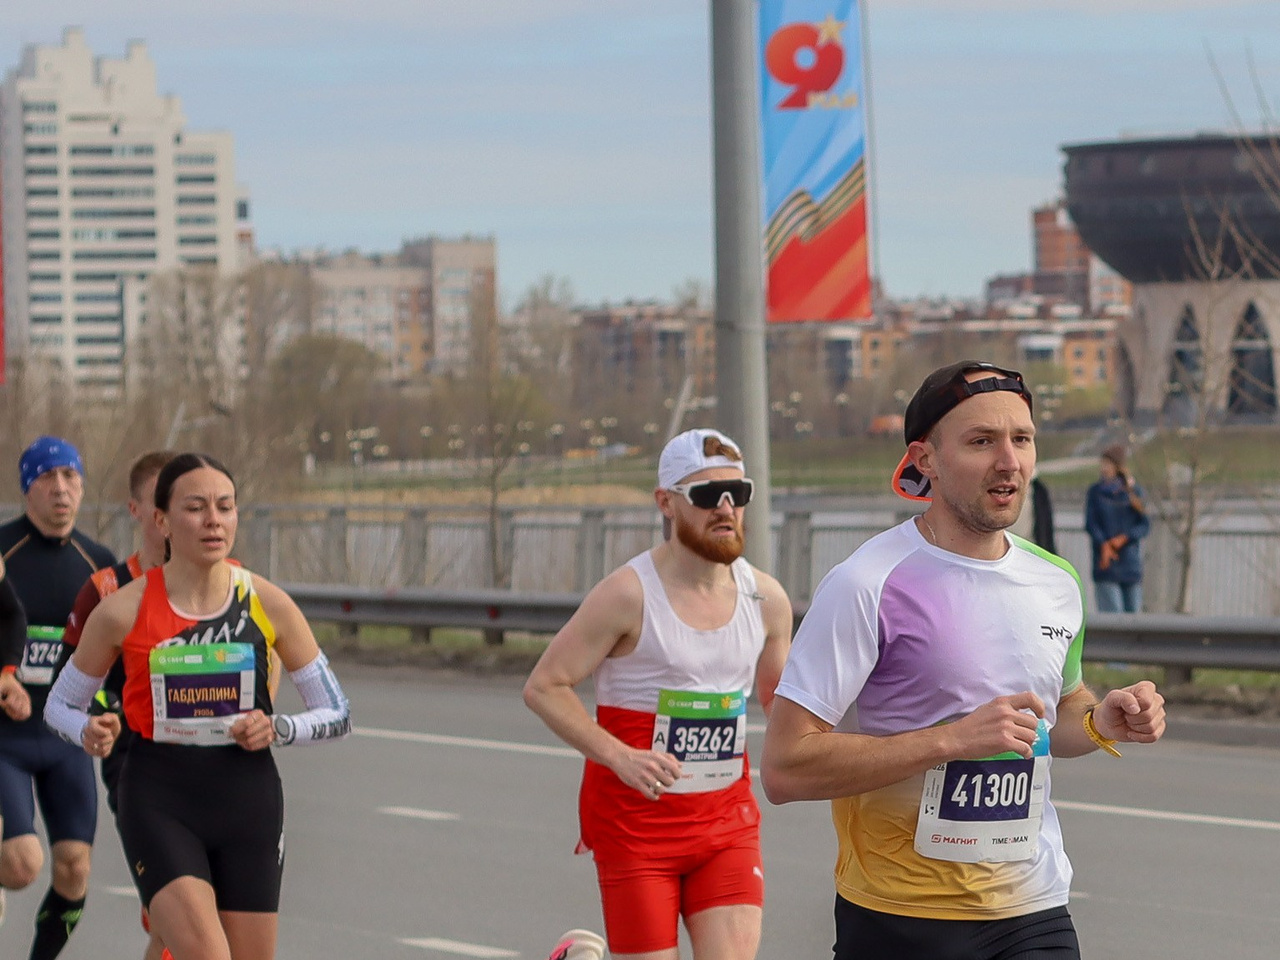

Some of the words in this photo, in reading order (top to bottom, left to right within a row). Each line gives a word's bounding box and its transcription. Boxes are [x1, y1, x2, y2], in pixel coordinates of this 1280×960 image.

[167, 686, 238, 704] ГАБДУЛЛИНА
[673, 726, 735, 753] 35262
[951, 772, 1029, 808] 41300
[943, 836, 978, 846] МАГНИТ
